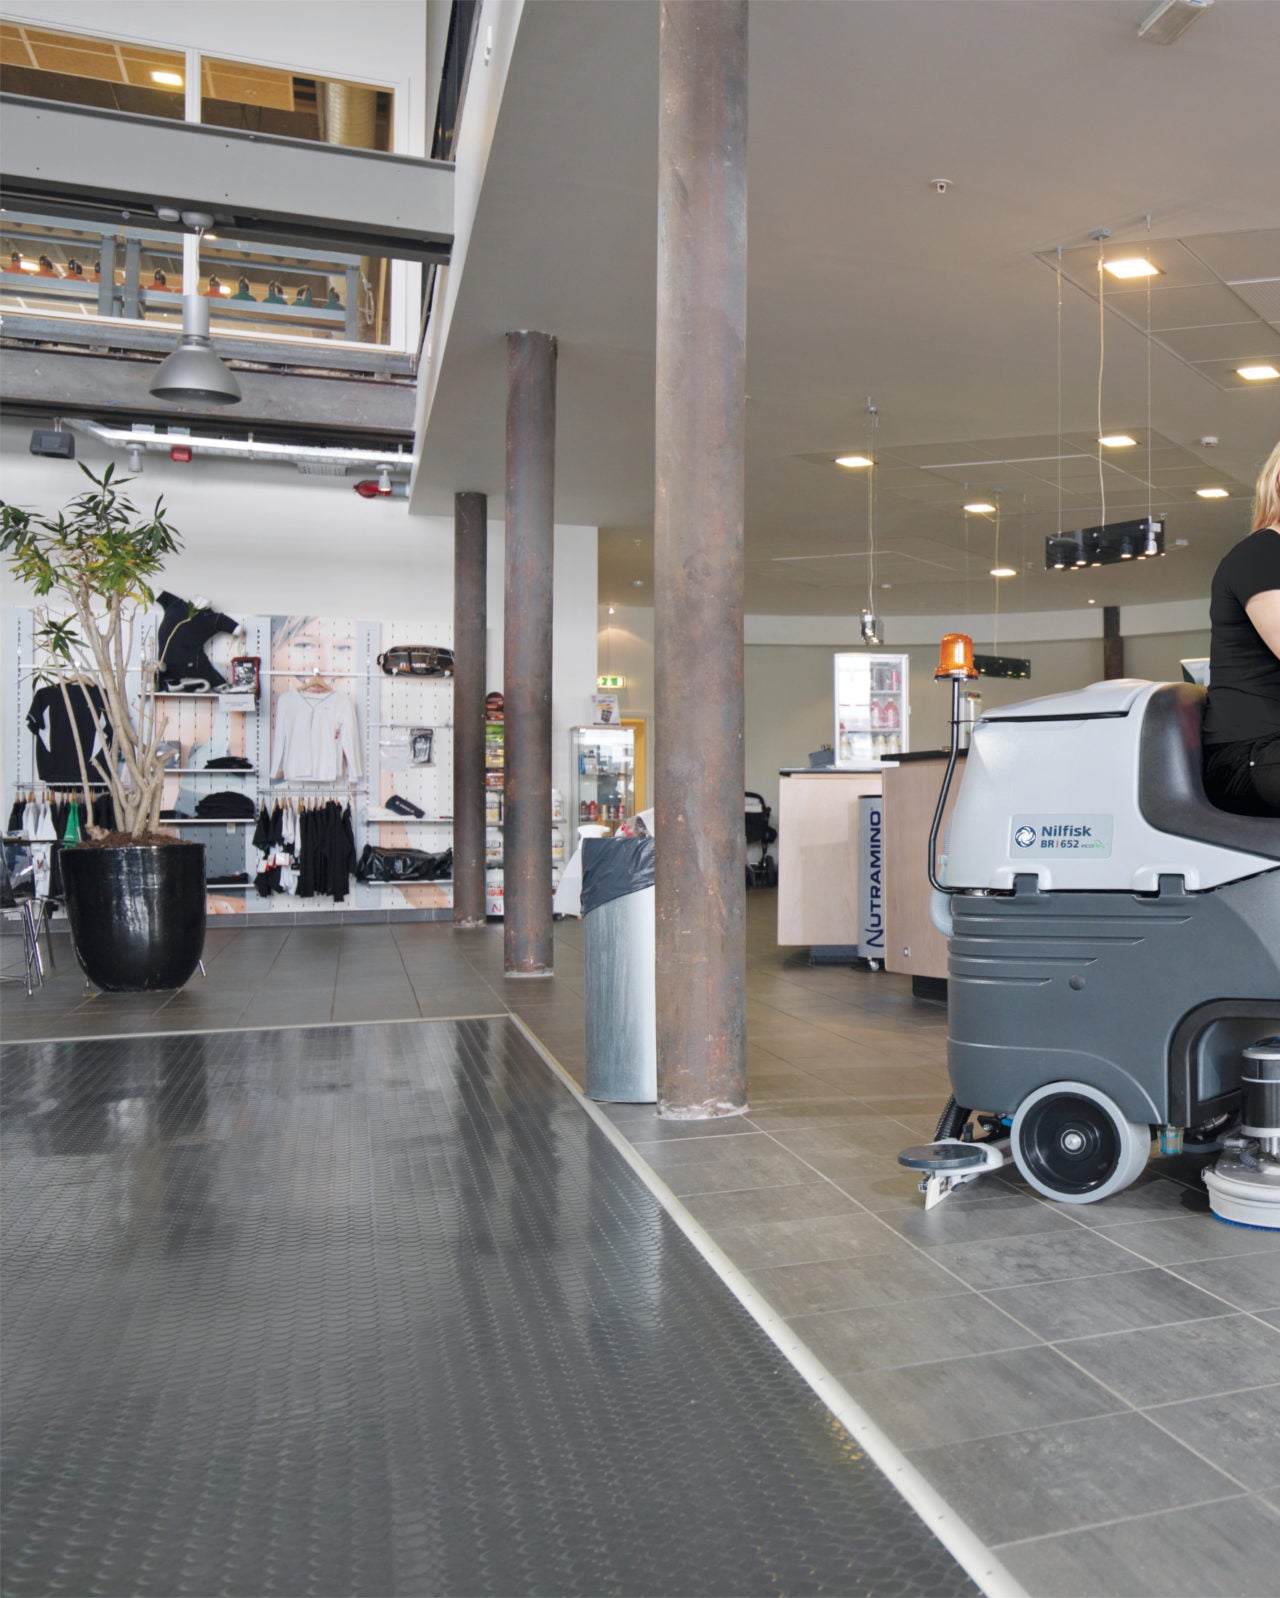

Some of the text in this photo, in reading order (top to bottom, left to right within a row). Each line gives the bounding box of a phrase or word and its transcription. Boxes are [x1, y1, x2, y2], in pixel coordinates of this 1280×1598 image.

[1041, 825, 1091, 837] Nilfisk
[1060, 839, 1079, 849] 652
[865, 810, 885, 947] NUTRAMINO
